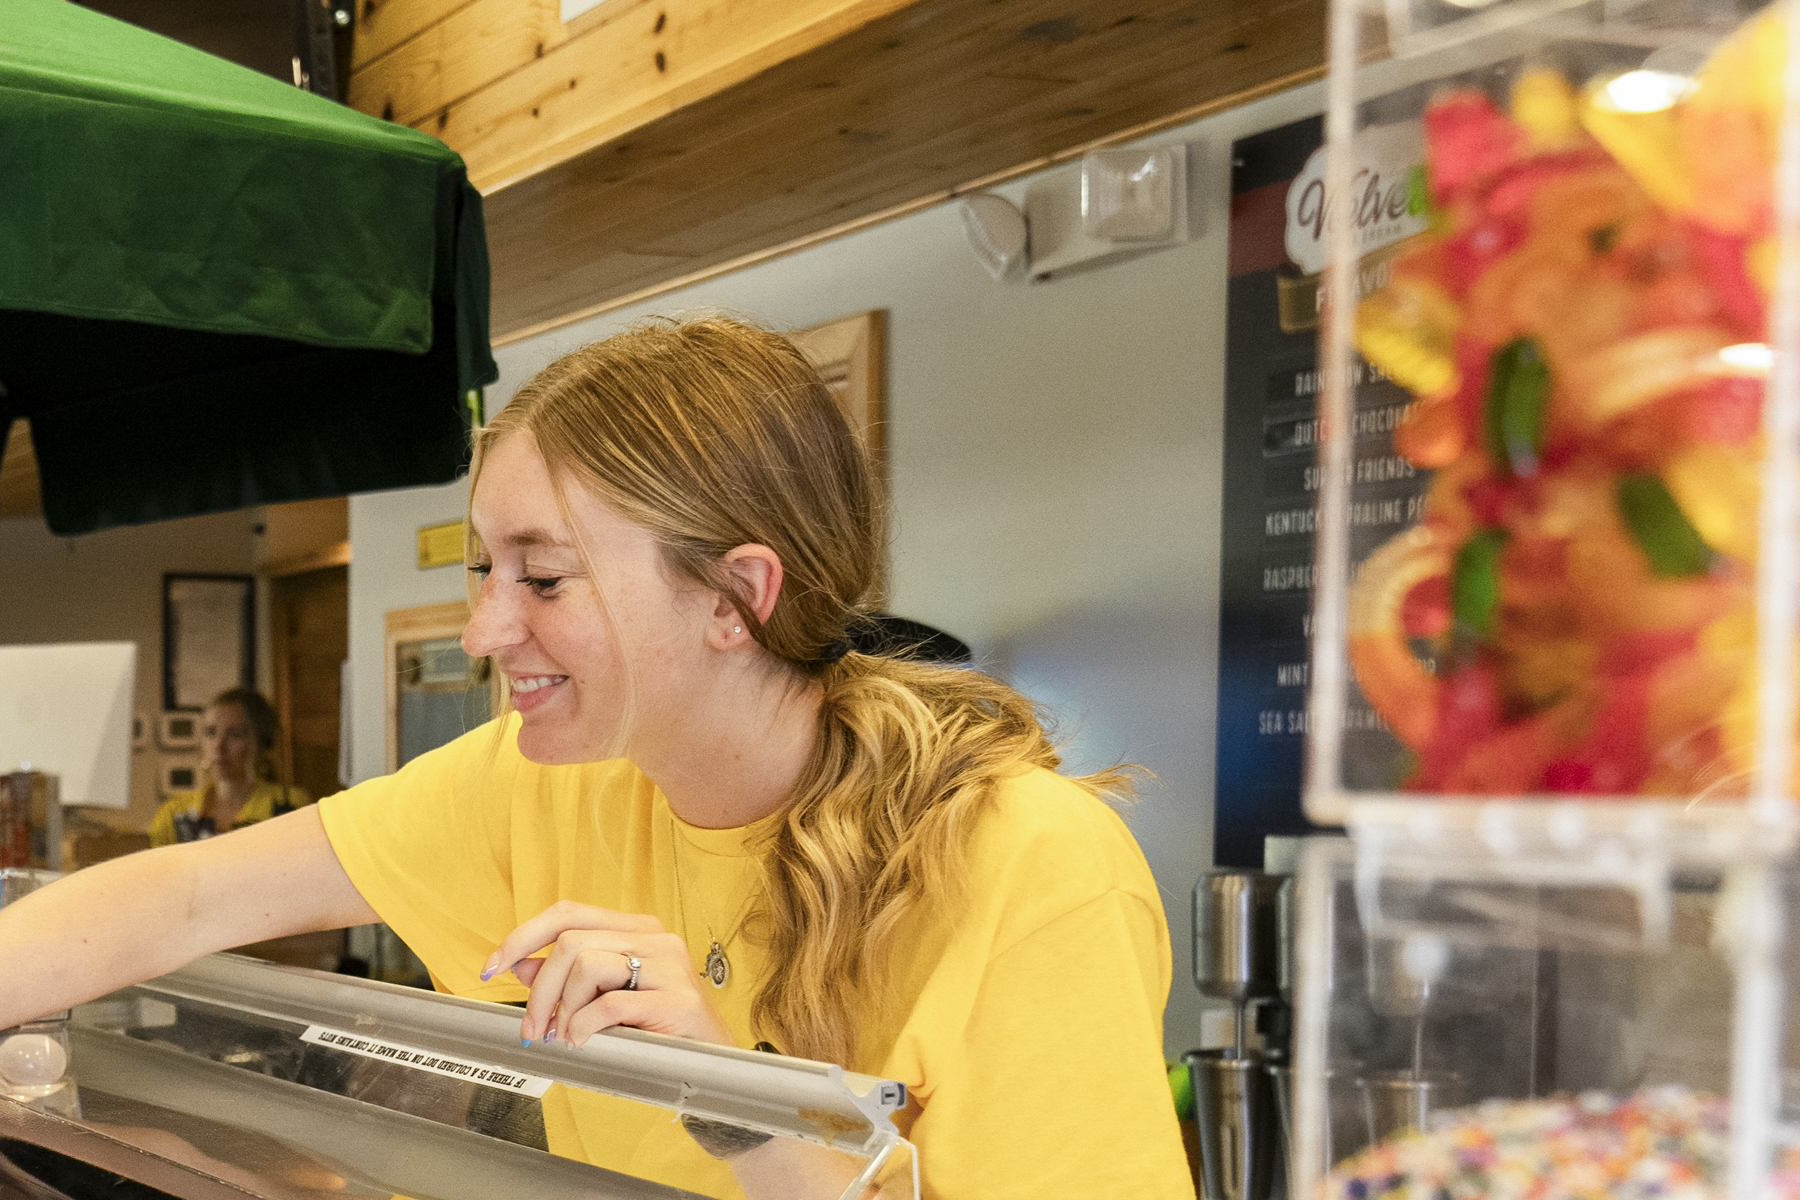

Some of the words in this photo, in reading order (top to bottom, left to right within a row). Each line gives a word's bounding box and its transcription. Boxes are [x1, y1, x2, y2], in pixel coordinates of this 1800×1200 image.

[1297, 168, 1412, 242] Vlve
[1295, 364, 1362, 396] RAINOW
[1351, 401, 1417, 437] CHOCOLA
[1356, 456, 1416, 483] FRIENDS
[1265, 509, 1322, 537] KENTUCK
[1263, 565, 1318, 592] RASPBE
[1277, 662, 1309, 687] MINT
[1258, 711, 1283, 736] SEA
[1287, 709, 1312, 735] SAL
[318, 1031, 338, 1044] NUTS
[335, 1036, 369, 1050] CONTAINS
[367, 1043, 378, 1053] IT
[375, 1045, 398, 1058] NAME
[395, 1050, 413, 1061] THE
[411, 1053, 424, 1064] ON
[422, 1056, 440, 1068] DOT
[437, 1060, 472, 1075] COLORED
[470, 1068, 480, 1077] A
[477, 1069, 489, 1080] IS
[486, 1072, 515, 1086] THERE
[513, 1078, 527, 1088] IF
